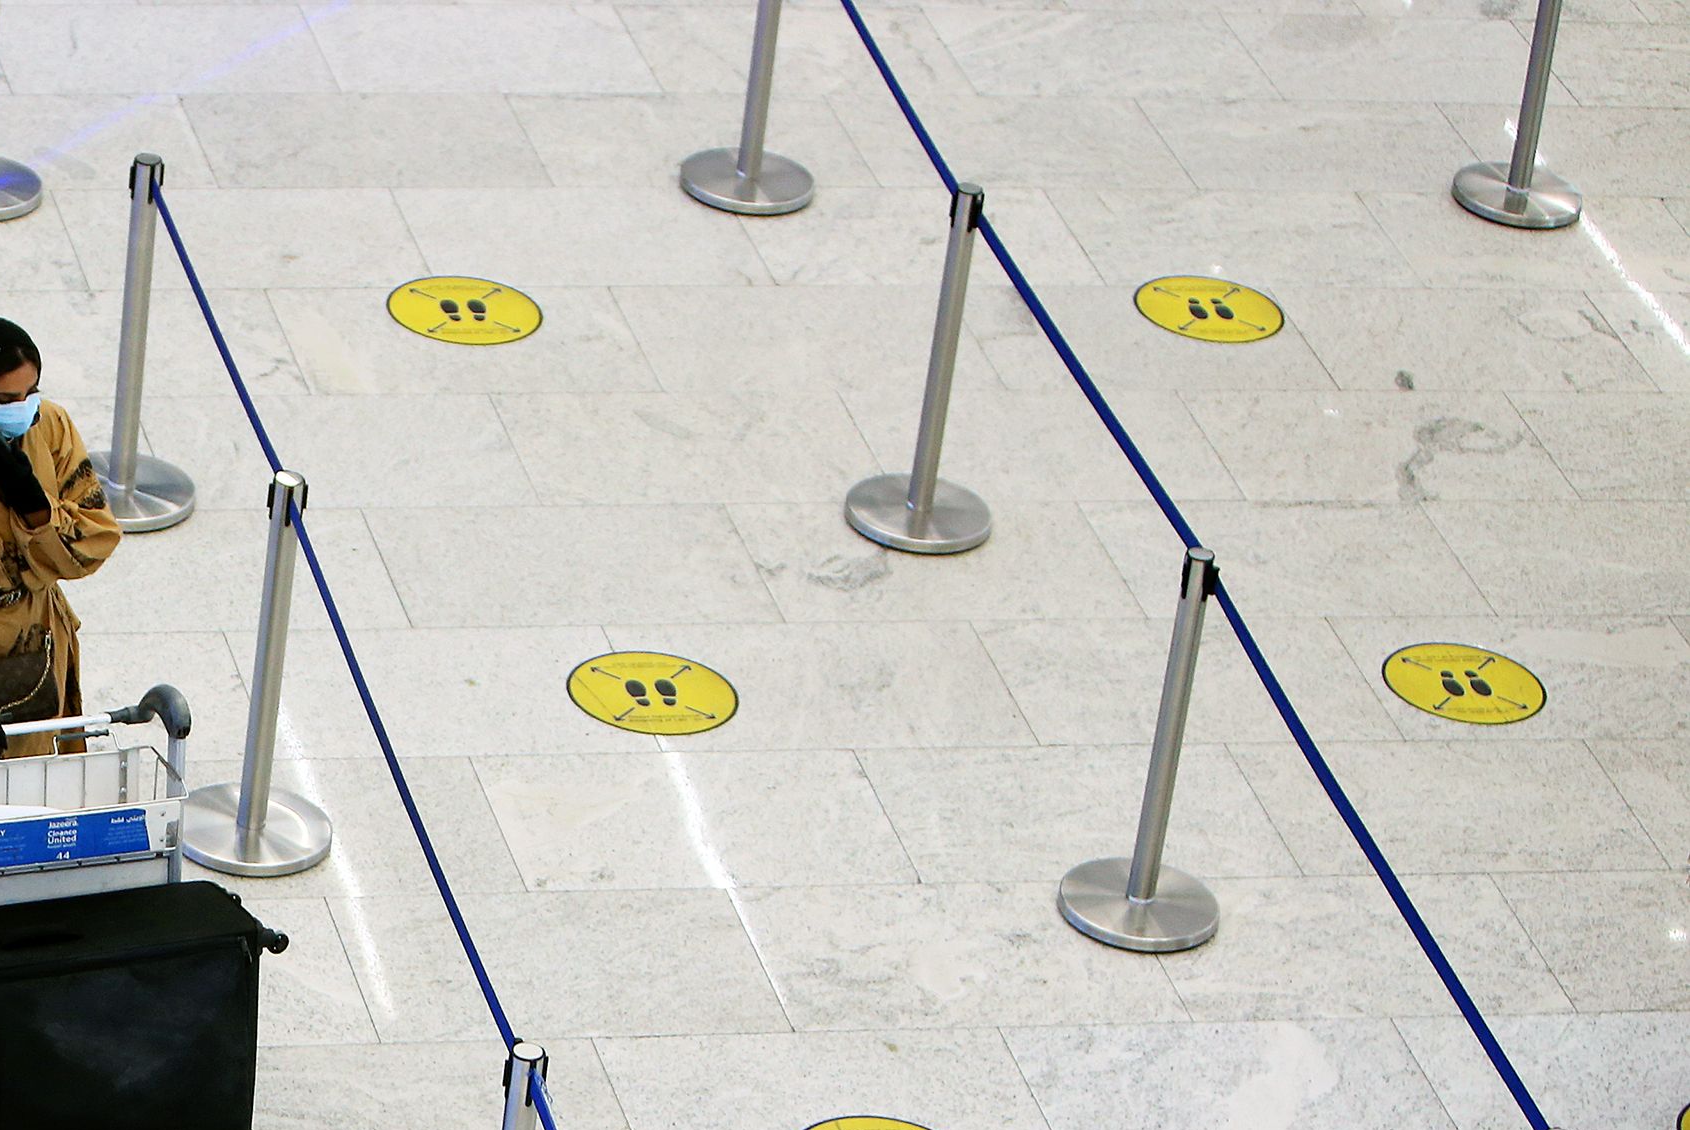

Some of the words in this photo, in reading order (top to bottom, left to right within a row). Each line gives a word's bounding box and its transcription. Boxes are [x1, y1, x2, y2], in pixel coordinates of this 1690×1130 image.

[48, 820, 77, 829] Jazeera
[48, 835, 77, 844] United
[56, 851, 70, 859] 44
